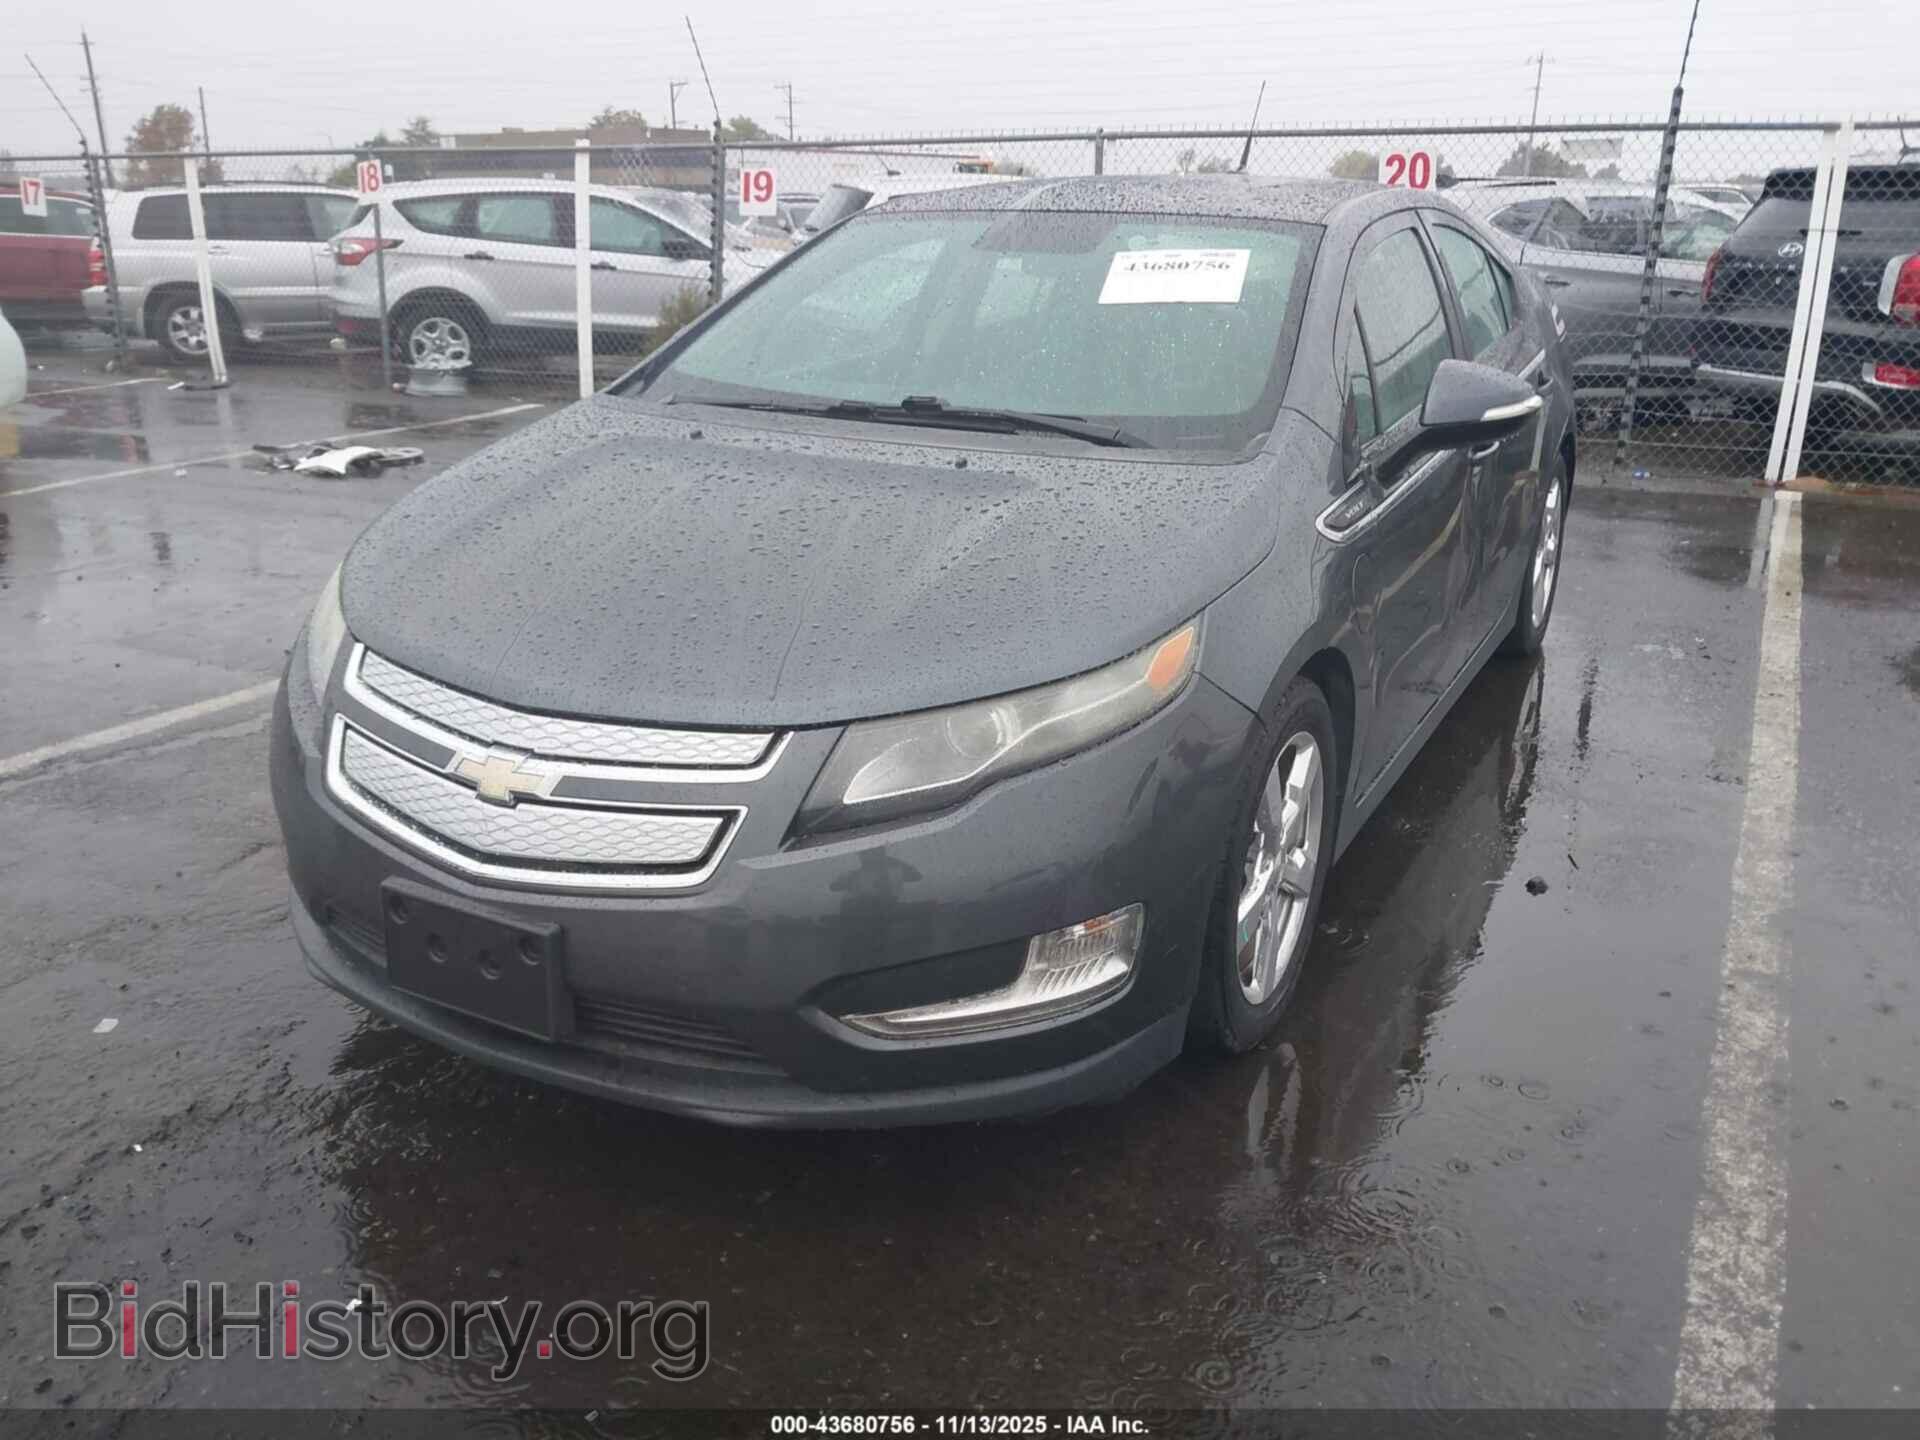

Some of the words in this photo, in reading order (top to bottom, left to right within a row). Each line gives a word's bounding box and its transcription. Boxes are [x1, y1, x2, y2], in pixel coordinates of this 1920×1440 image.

[361, 163, 380, 193] 18
[1386, 152, 1430, 189] 20
[23, 180, 41, 206] 17
[743, 171, 773, 203] 19
